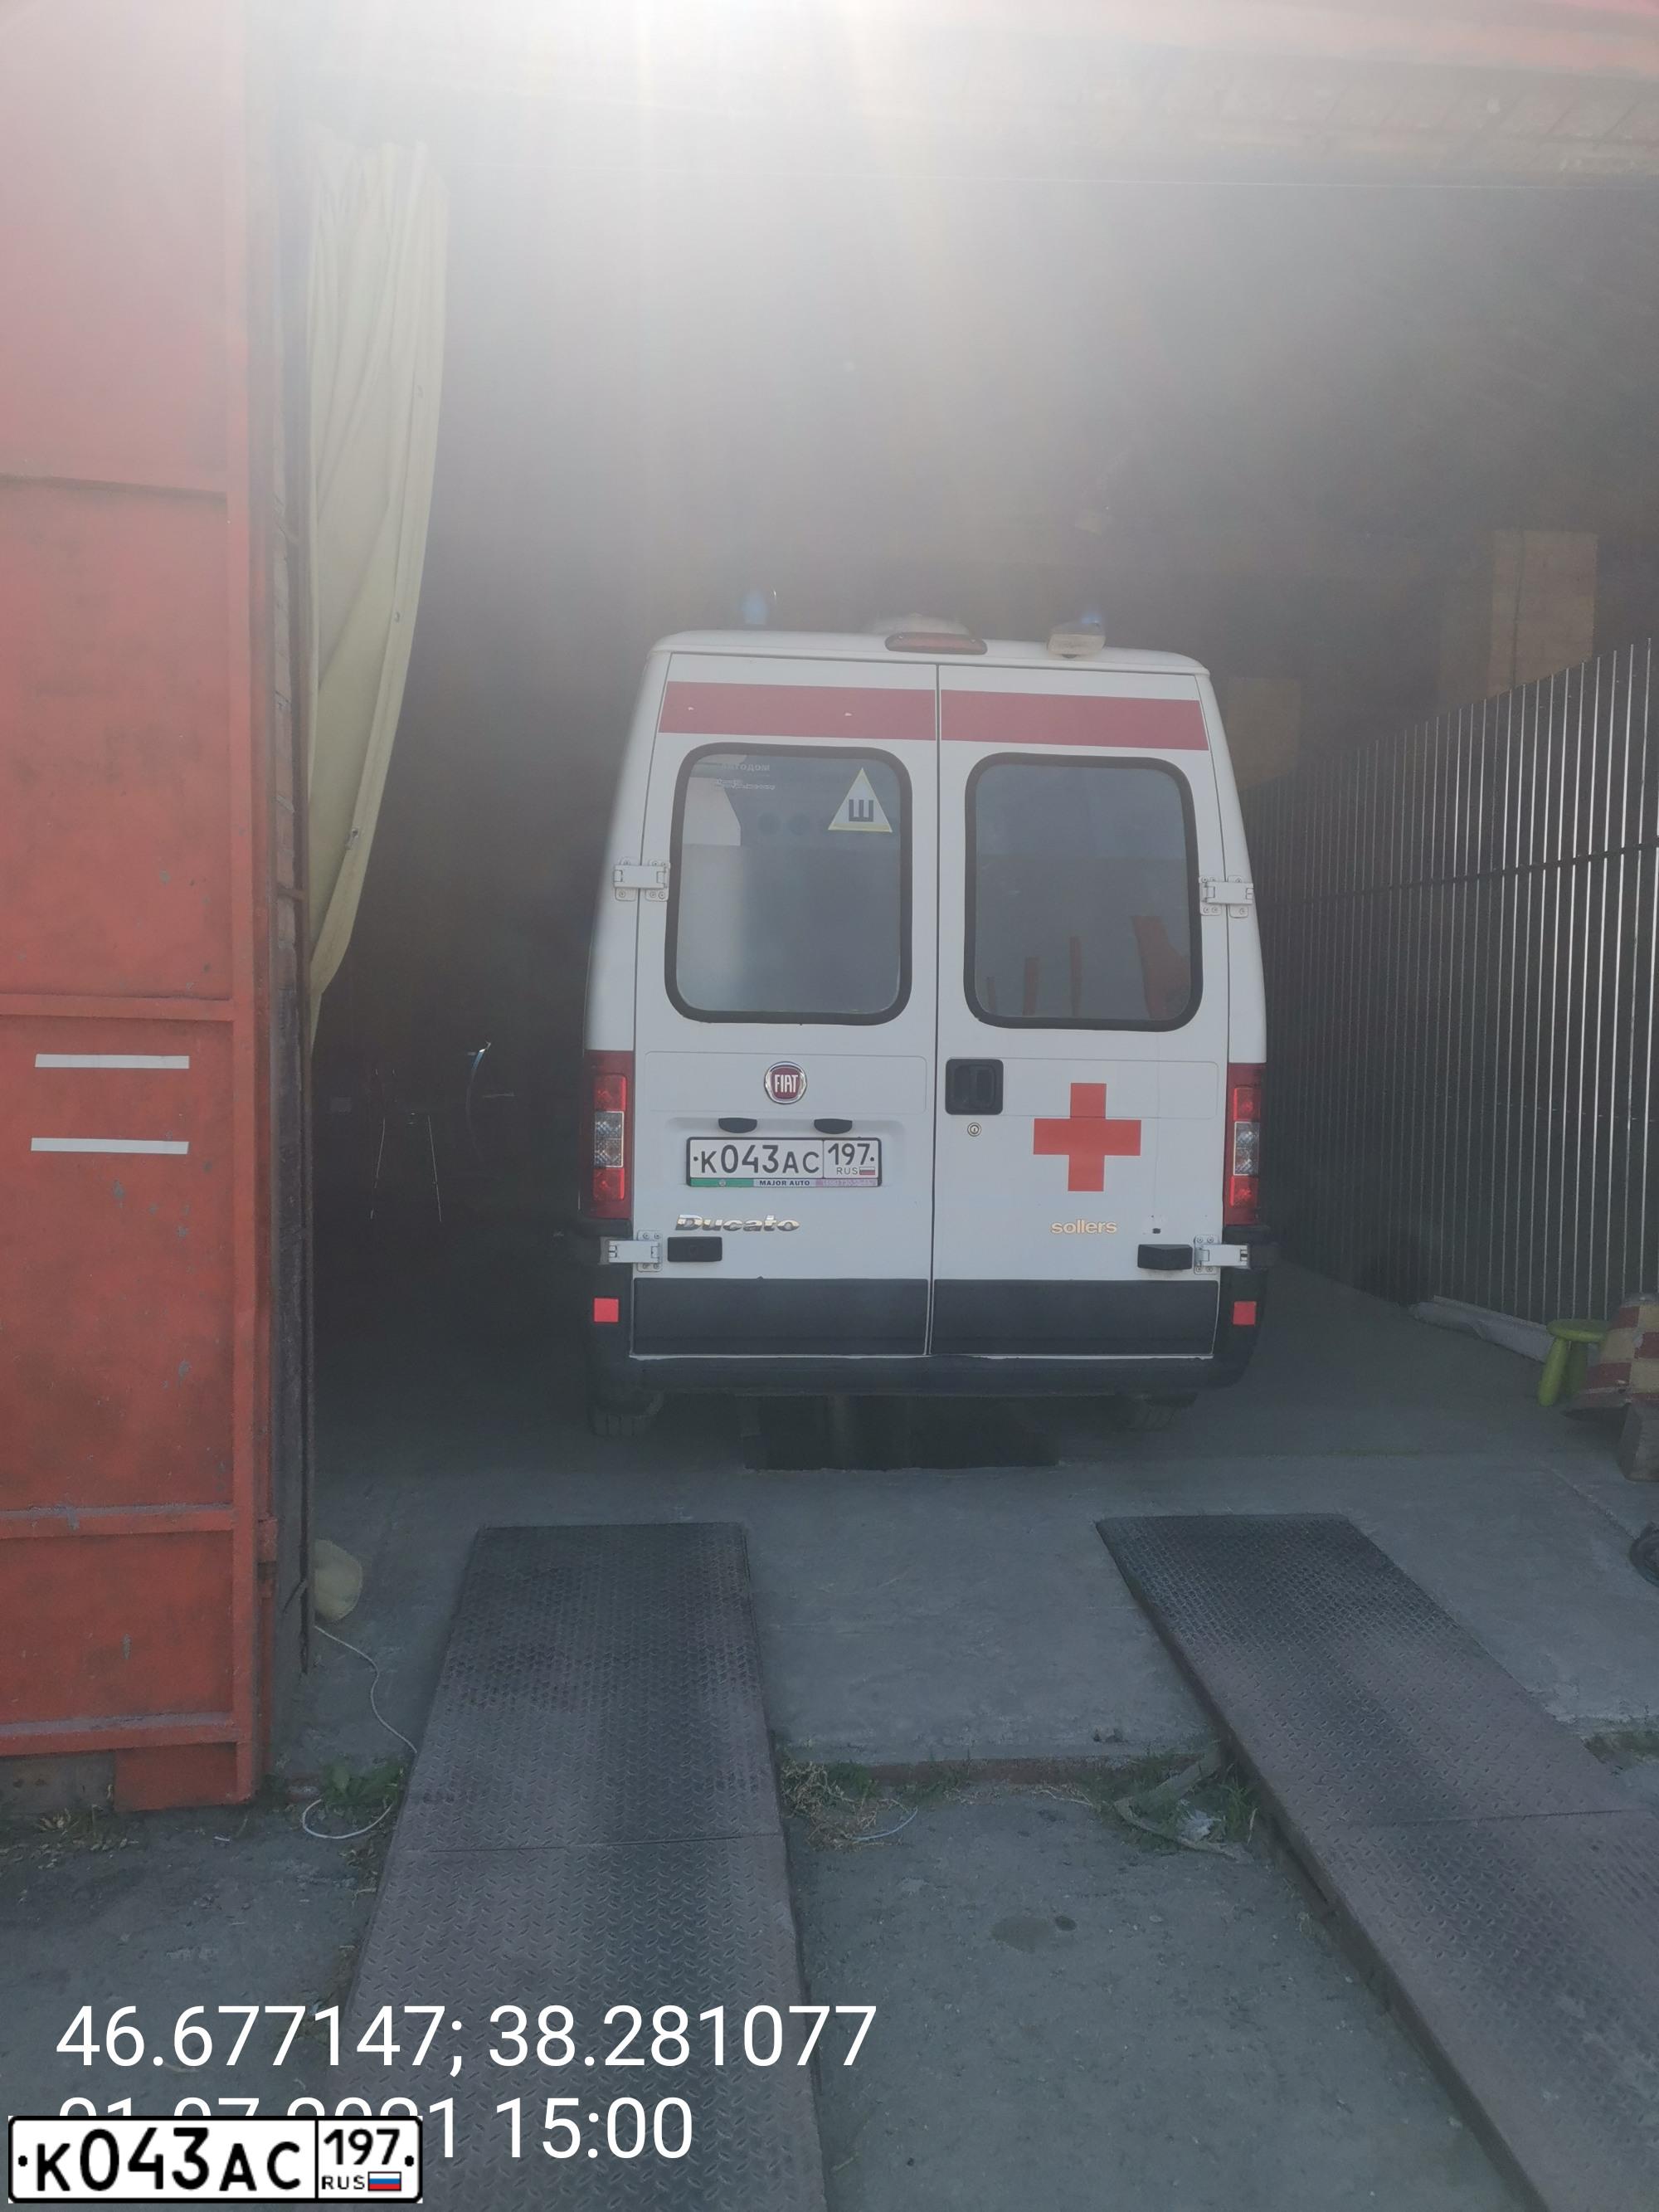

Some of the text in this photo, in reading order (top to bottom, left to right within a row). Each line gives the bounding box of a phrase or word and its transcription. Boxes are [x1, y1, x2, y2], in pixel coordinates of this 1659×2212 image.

[849, 799, 874, 822] Ш
[774, 1074, 799, 1094] FIAT
[701, 1143, 871, 1173] К043АС 197
[836, 1167, 858, 1175] RUS
[675, 1214, 800, 1231] Ducato
[1049, 1219, 1117, 1234] sollers
